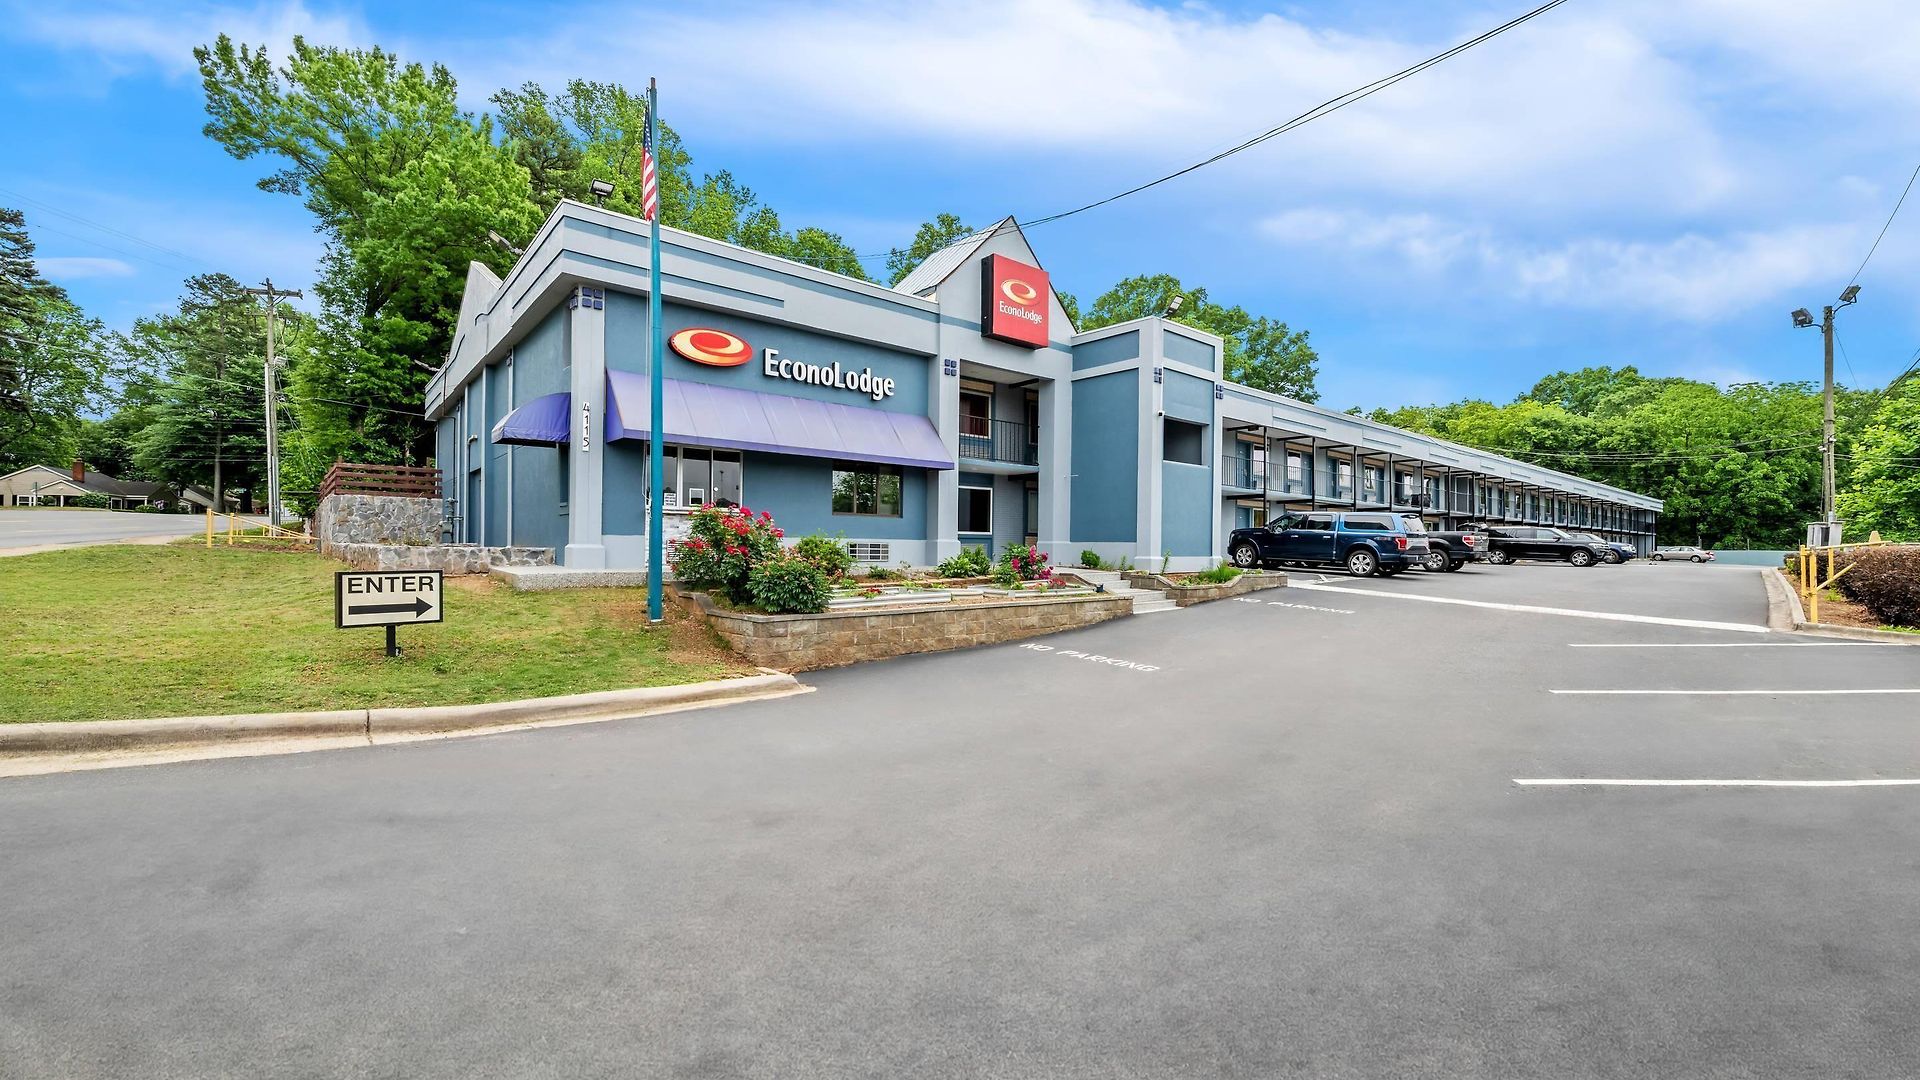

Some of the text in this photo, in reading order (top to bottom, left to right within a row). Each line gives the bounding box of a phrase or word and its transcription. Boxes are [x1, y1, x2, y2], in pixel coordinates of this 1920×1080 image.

[999, 300, 1043, 324] EconoLodge
[764, 347, 895, 401] EconoLodge
[347, 576, 434, 593] ENTER
[1019, 643, 1161, 672] NO PARKING
